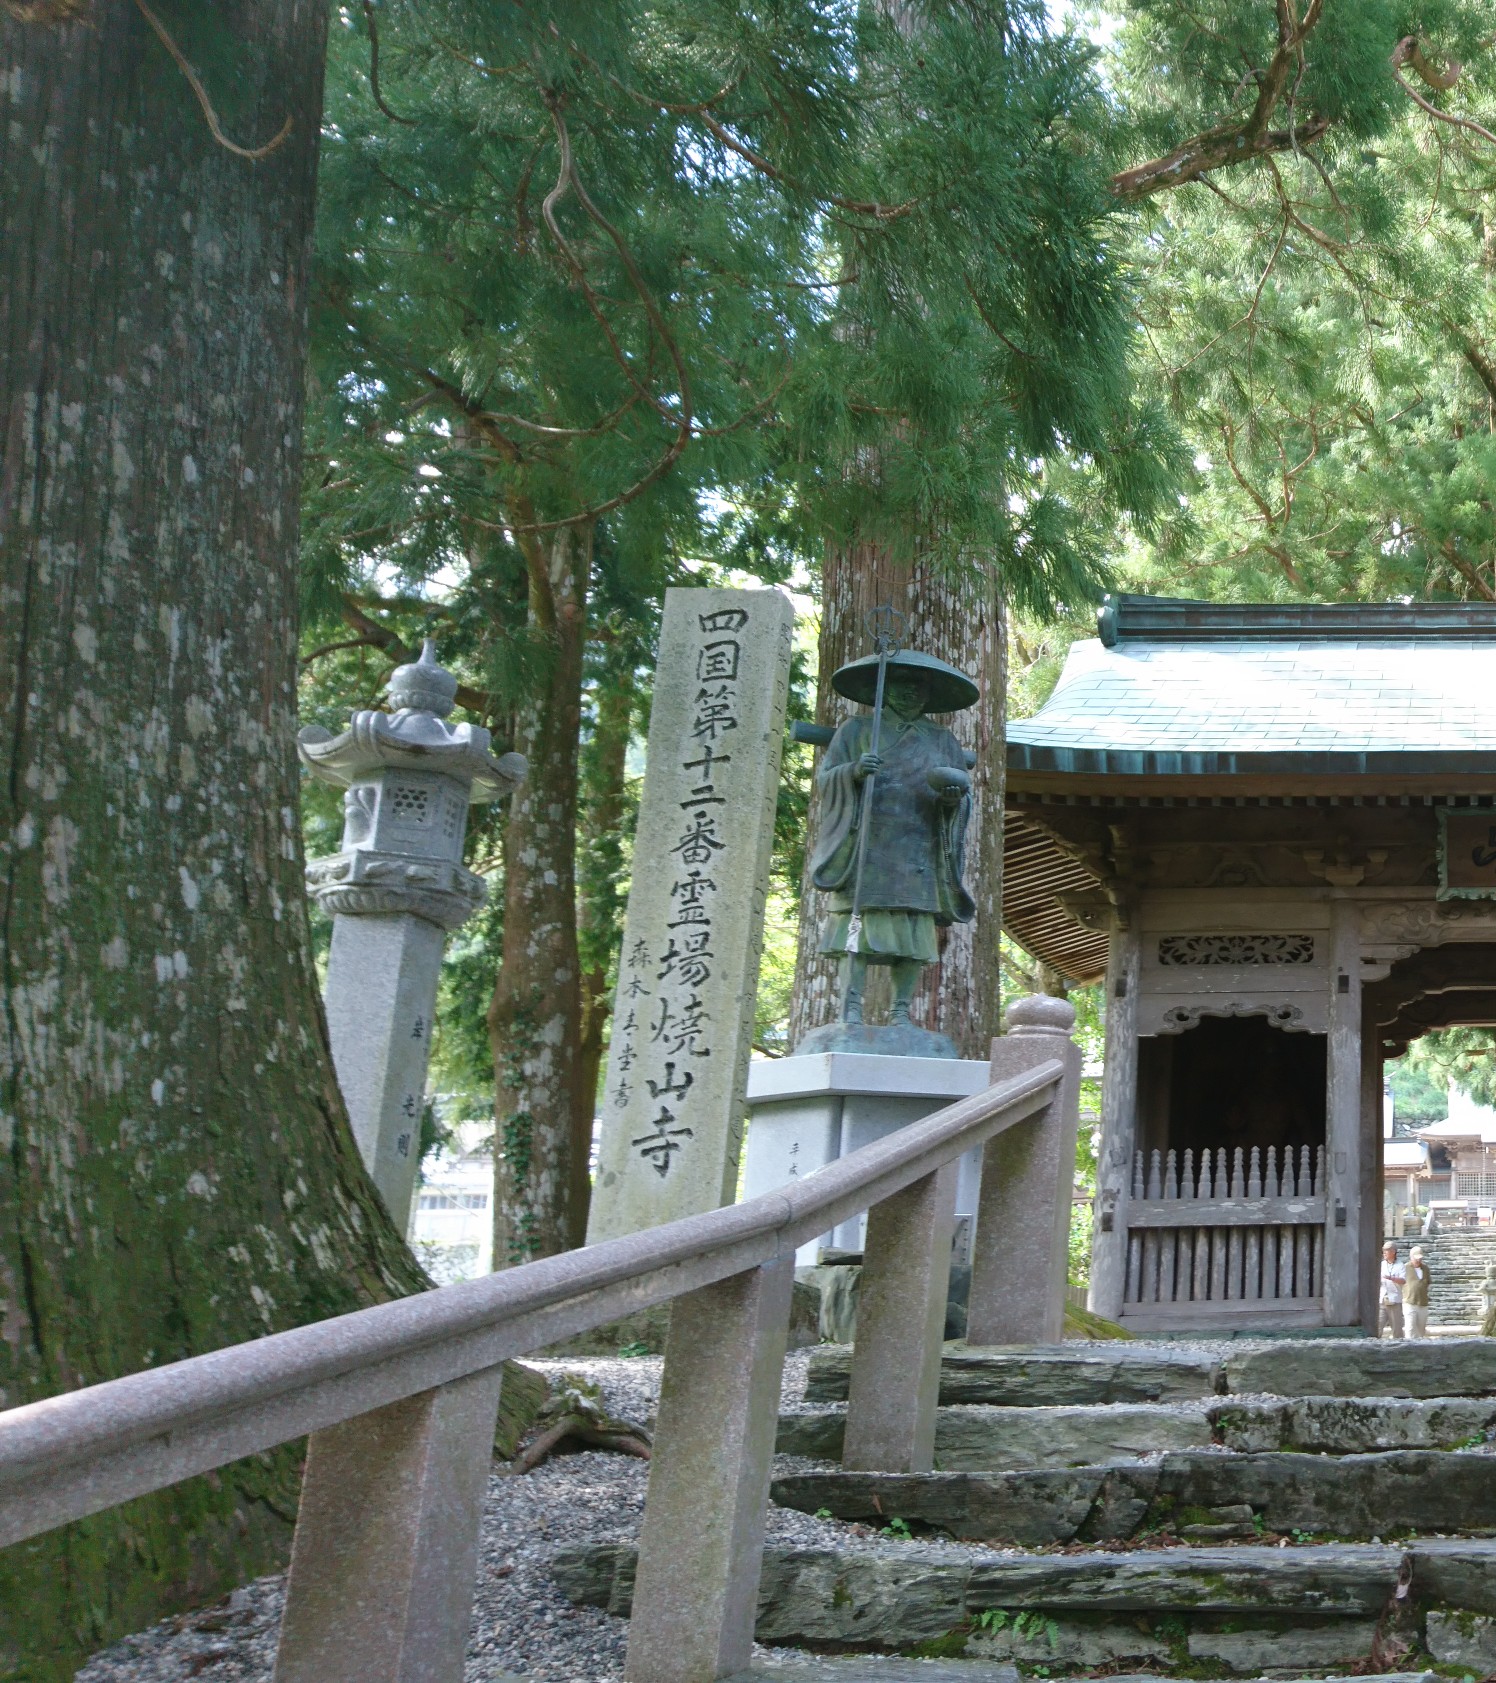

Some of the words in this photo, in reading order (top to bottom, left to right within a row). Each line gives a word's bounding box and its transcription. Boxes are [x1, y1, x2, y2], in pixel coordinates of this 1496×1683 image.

[631, 608, 749, 1178] 四国第十二番霊場焼山寺
